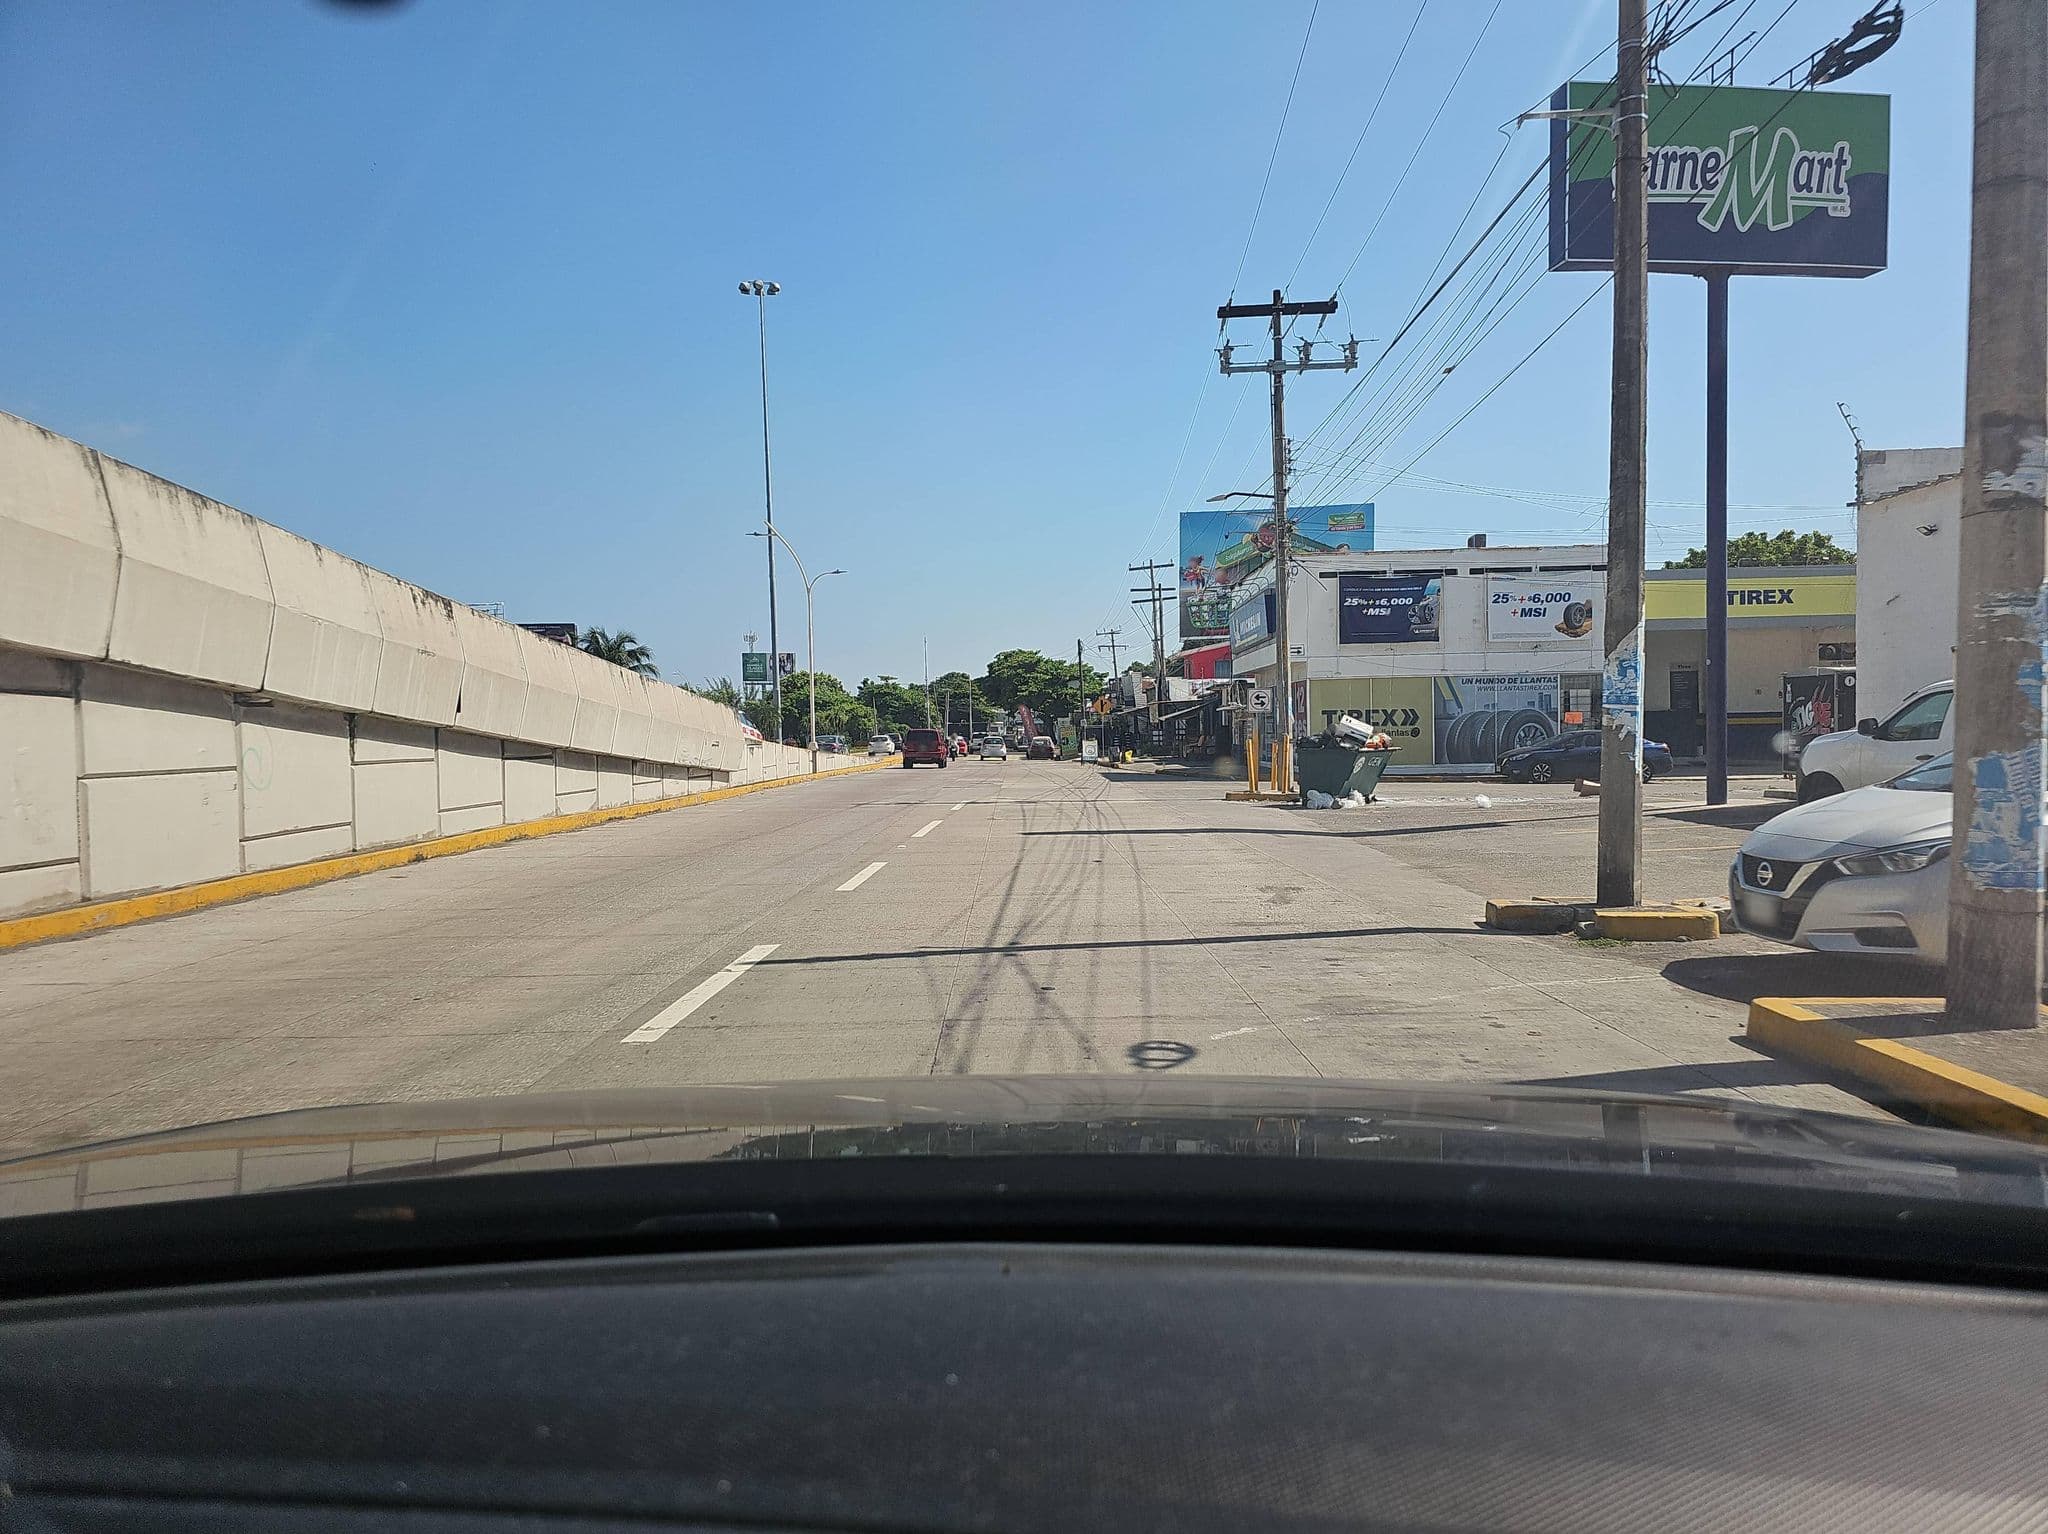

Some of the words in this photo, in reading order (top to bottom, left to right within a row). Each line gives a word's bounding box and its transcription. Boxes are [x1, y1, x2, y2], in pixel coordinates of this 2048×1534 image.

[1727, 588, 1794, 605] TIREX
[1475, 677, 1506, 685] MUNDO
[1508, 677, 1518, 685] DE
[1520, 676, 1558, 685] LLANTAS
